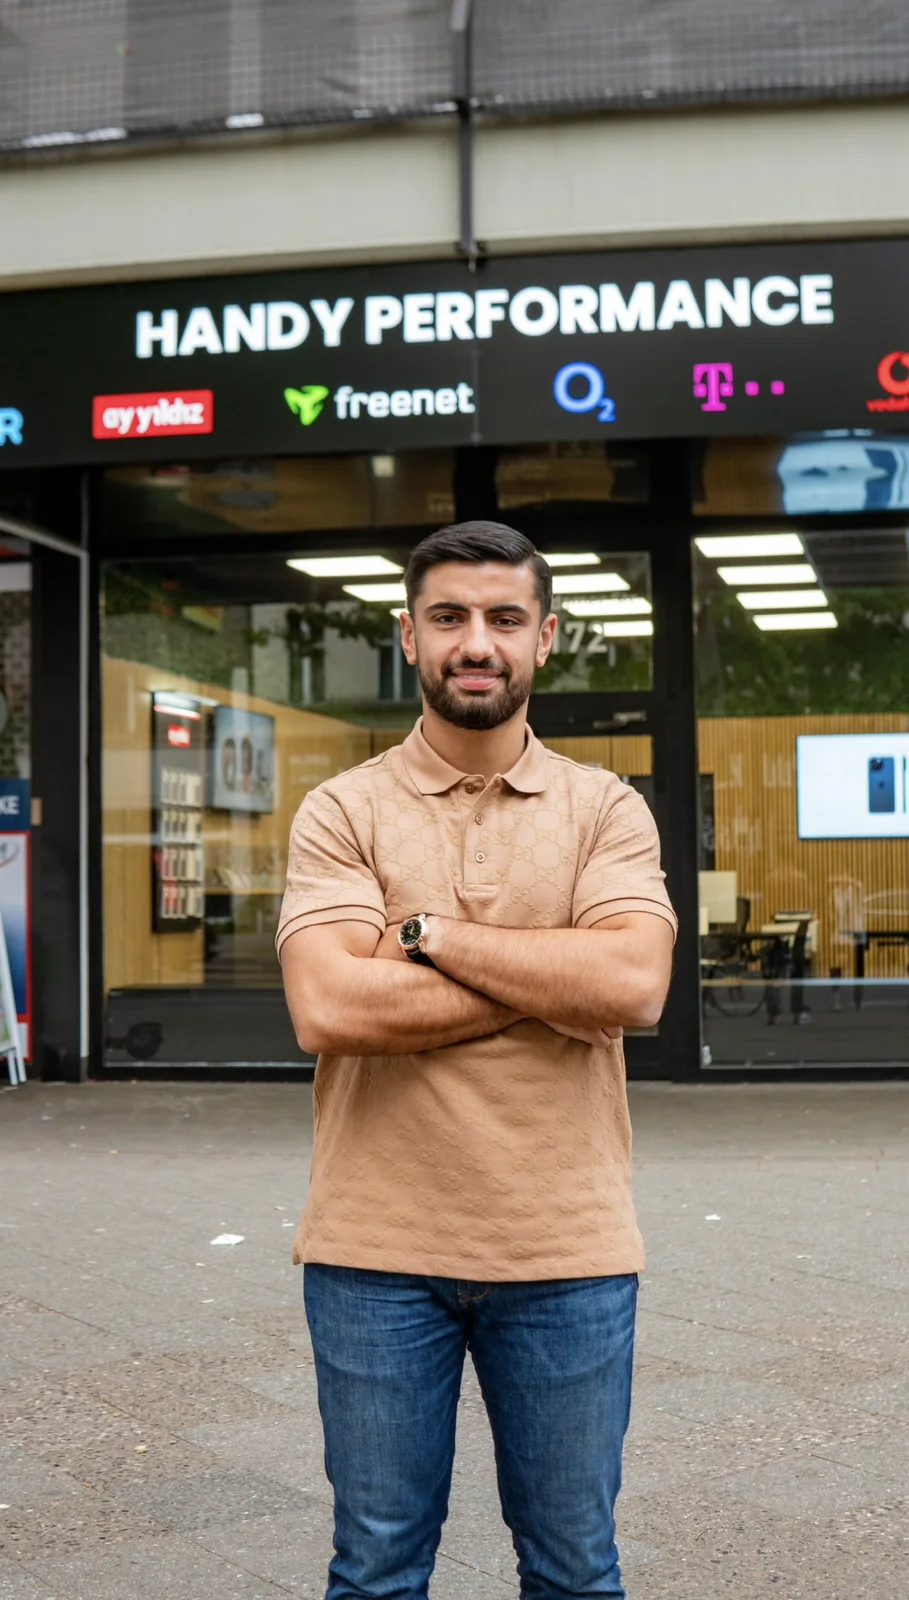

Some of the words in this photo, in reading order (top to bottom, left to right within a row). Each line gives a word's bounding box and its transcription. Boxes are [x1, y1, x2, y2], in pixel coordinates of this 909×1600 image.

[135, 297, 355, 359] HANDY
[364, 274, 834, 345] PERFORMANCE
[334, 382, 476, 419] freenet
